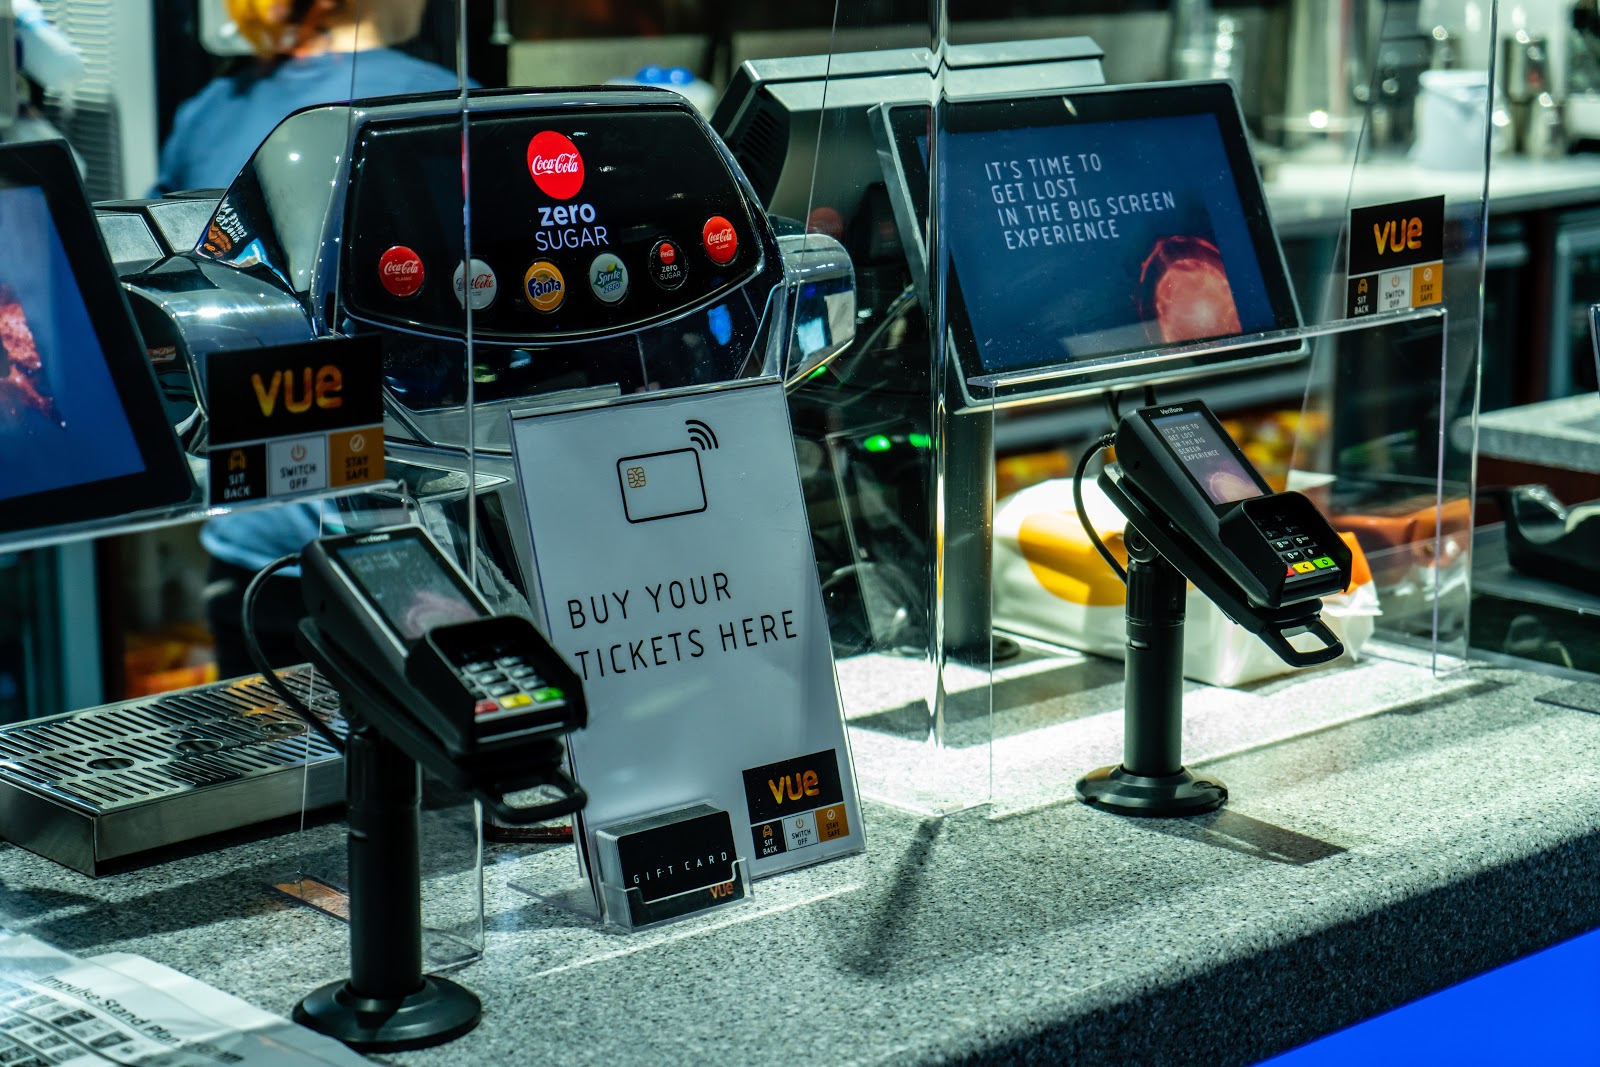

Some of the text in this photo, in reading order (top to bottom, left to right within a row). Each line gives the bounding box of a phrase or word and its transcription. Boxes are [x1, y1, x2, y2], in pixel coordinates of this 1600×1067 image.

[531, 152, 579, 176] Coca-Cola
[984, 153, 1102, 181] IT'S TIME TO
[991, 177, 1079, 204] GET LOST
[537, 203, 597, 227] zero
[997, 191, 1176, 227] IN THE BIG SCREEN
[535, 225, 610, 251] SUGAR
[707, 228, 733, 245] Coca-Cola
[1004, 219, 1121, 250] EXPERIENCE
[384, 259, 419, 276] Coca-Cola
[661, 264, 678, 273] zero
[597, 269, 621, 285] Sprite
[660, 270, 682, 280] SUGAR
[527, 276, 562, 299] Fanta
[1420, 283, 1434, 293] STAY
[1357, 295, 1367, 305] SIT
[1384, 289, 1405, 300] SWITCH
[1420, 293, 1433, 302] SAFE
[1354, 304, 1369, 315] BACK
[1389, 299, 1400, 308] OFF
[1162, 427, 1176, 435] IT'S
[1175, 424, 1191, 432] TIME
[1168, 431, 1195, 442] GET LOST
[1194, 437, 1206, 445] BIG
[1179, 446, 1202, 455] SCREEN
[1183, 449, 1220, 462] EXPERIENCE
[343, 455, 369, 468] STAY
[280, 462, 317, 479] SWITCH
[228, 472, 246, 485] SIT
[289, 476, 308, 490] OFF
[223, 486, 251, 500] BACK
[567, 572, 731, 629] BUY YOUR
[574, 629, 705, 680] TICKETS
[719, 610, 797, 652] HERE
[826, 821, 839, 831] STAY
[791, 829, 812, 840] SWITCH
[827, 829, 841, 838] SAFE
[764, 838, 773, 847] SIT
[797, 838, 808, 846] OFF
[763, 846, 778, 856] BACK
[633, 851, 728, 885] GIFT CARD
[98, 998, 152, 1027] Stand
[142, 1023, 182, 1044] Plan
